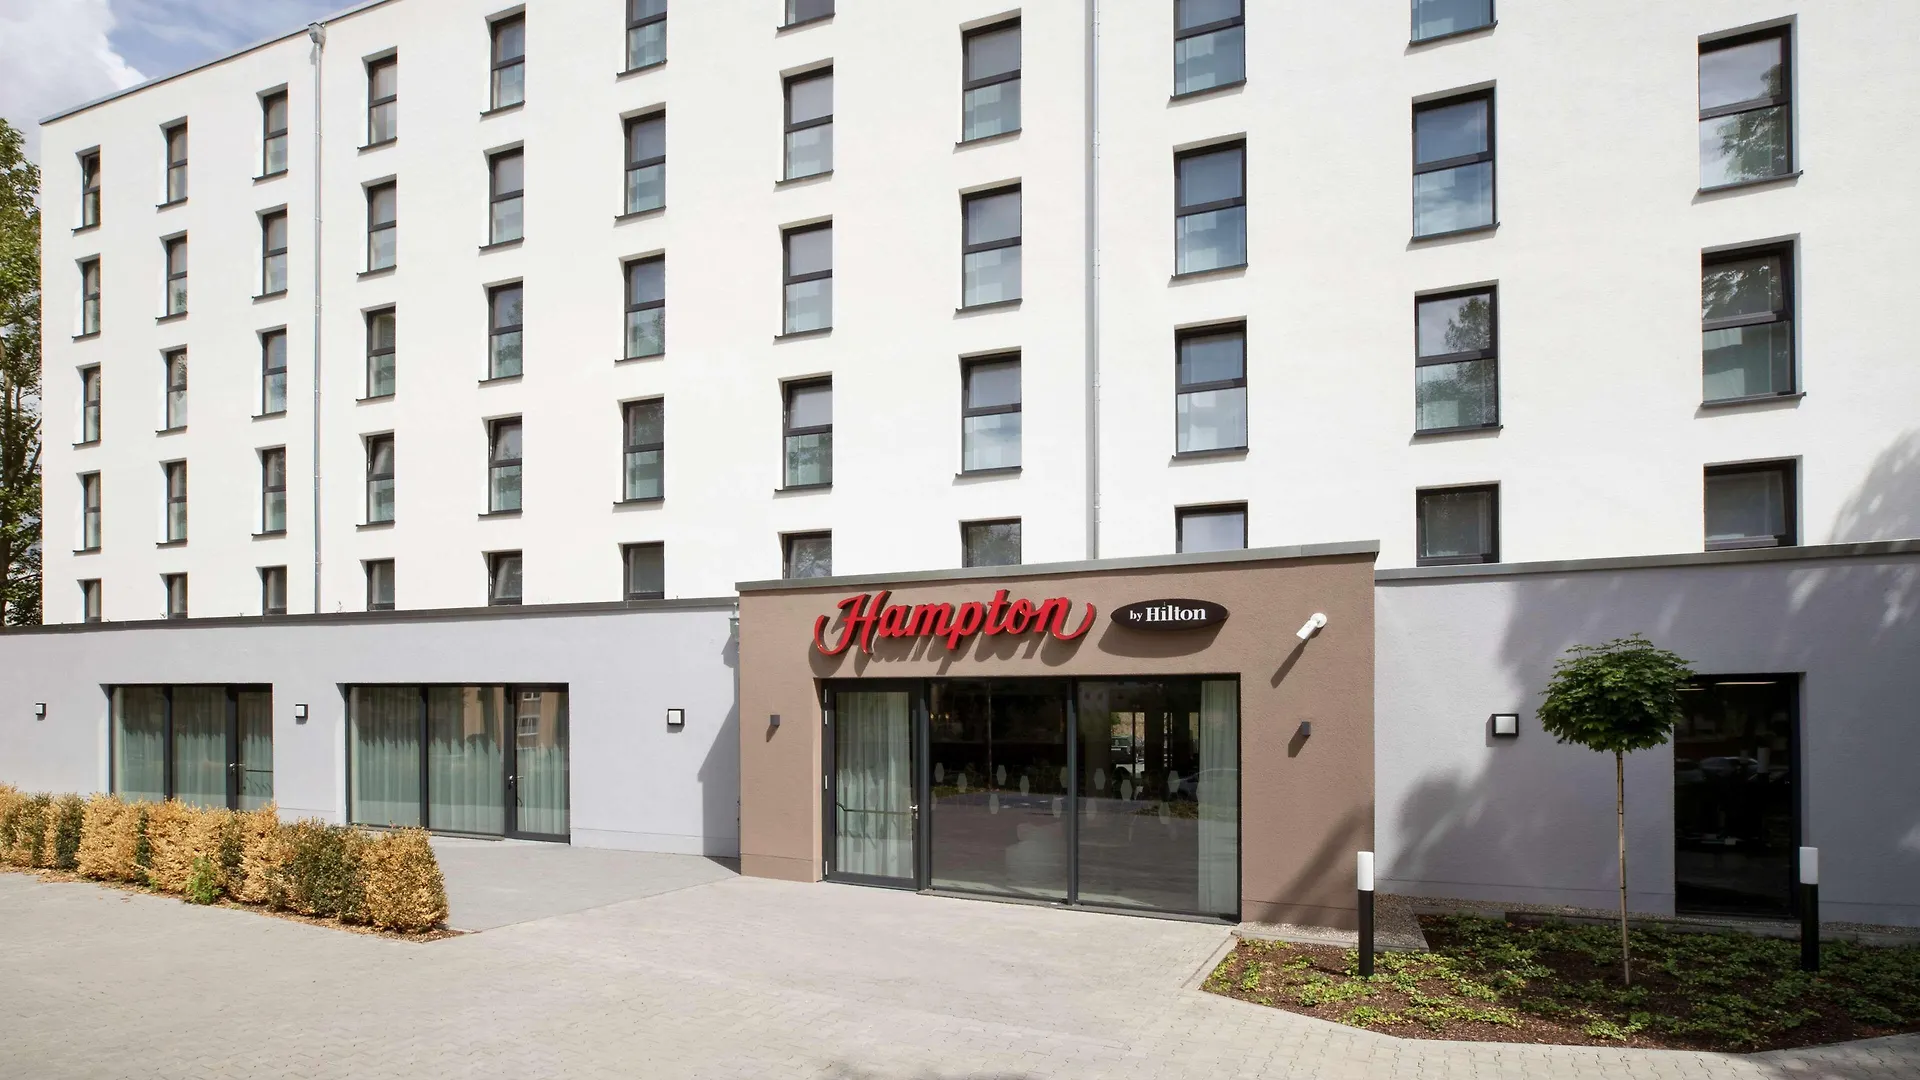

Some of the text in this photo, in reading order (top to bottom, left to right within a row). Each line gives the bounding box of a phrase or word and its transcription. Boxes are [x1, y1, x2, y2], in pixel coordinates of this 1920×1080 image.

[814, 589, 1096, 656] Hampton
[1129, 605, 1207, 622] by Hilton
